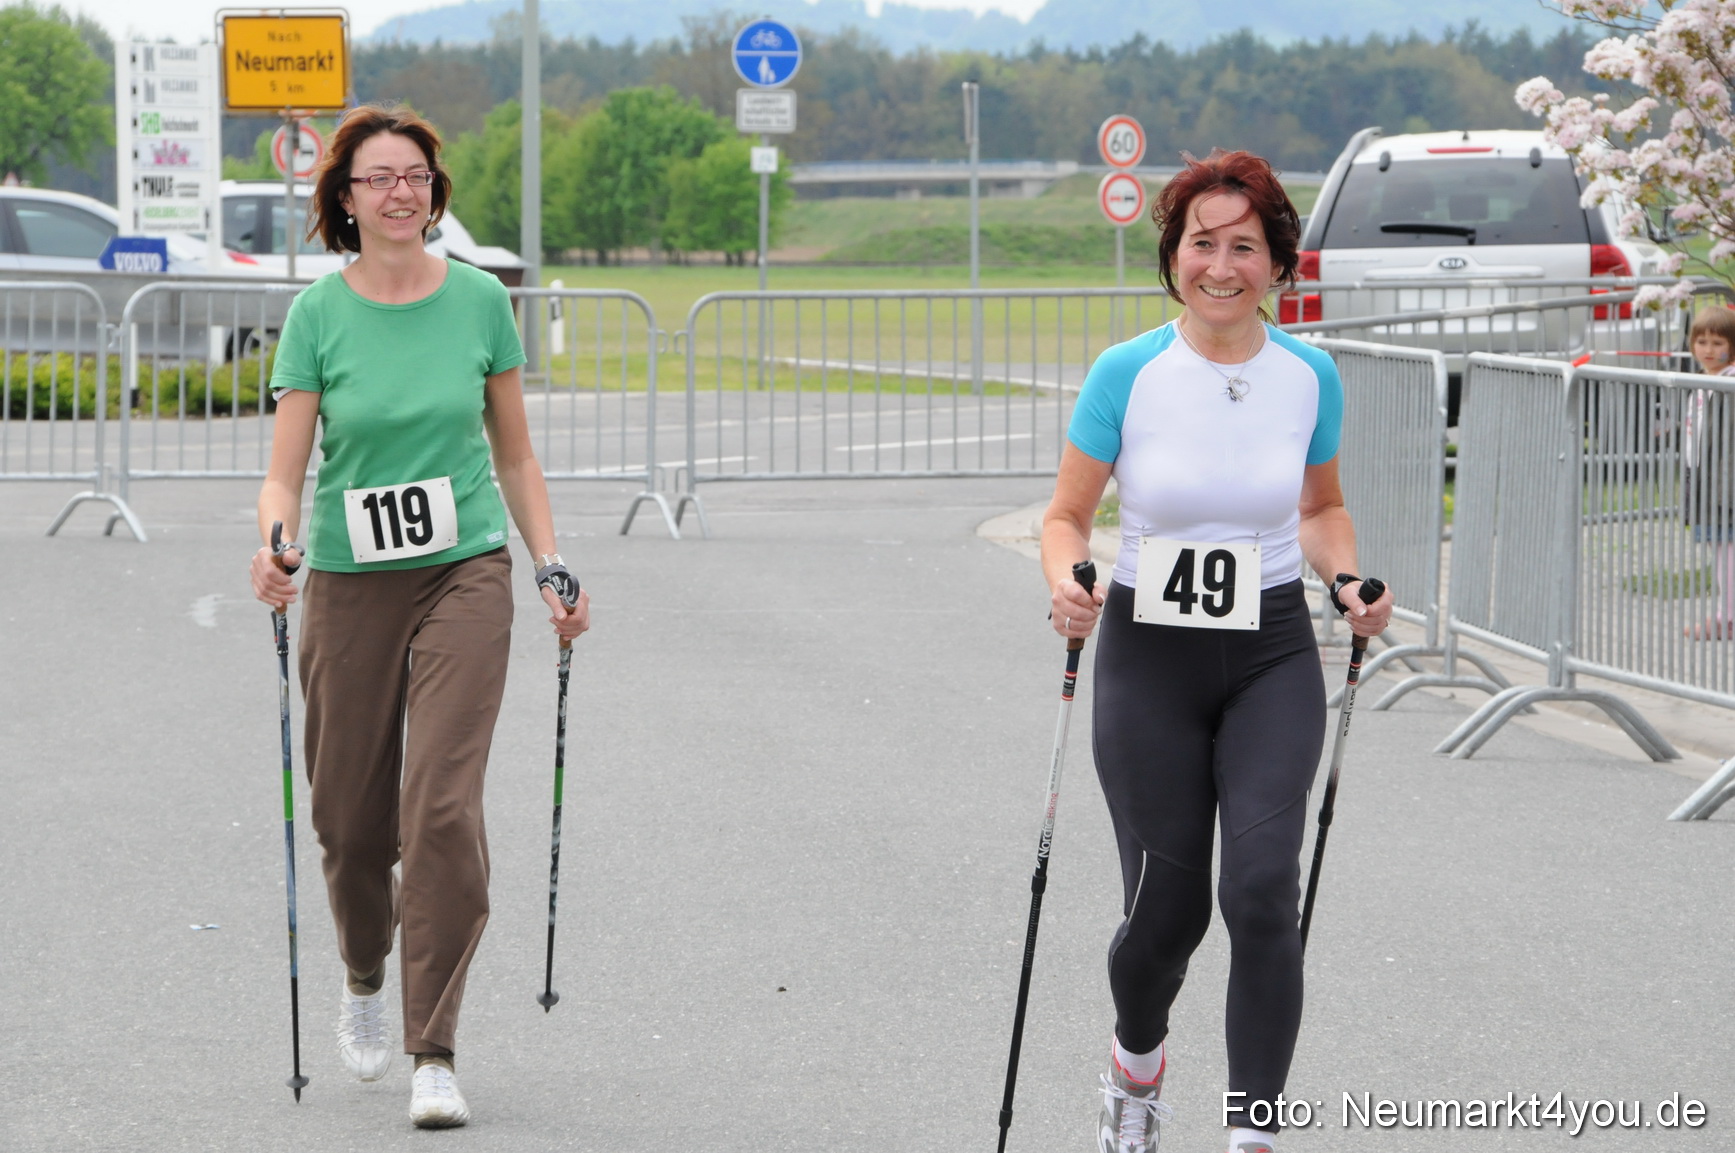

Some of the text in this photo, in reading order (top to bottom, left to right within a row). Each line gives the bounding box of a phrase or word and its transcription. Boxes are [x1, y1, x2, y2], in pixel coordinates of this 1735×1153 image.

[267, 31, 301, 42] Nach
[235, 49, 334, 72] Neumarkt
[269, 80, 305, 93] 5 km
[1110, 132, 1134, 153] 60
[142, 175, 174, 198] THULE
[113, 252, 163, 272] VOLVO
[1440, 258, 1466, 269] KIA
[362, 486, 434, 551] 119
[1163, 548, 1236, 618] 49
[1038, 818, 1054, 859] Nordic
[1046, 792, 1059, 819] Hiking
